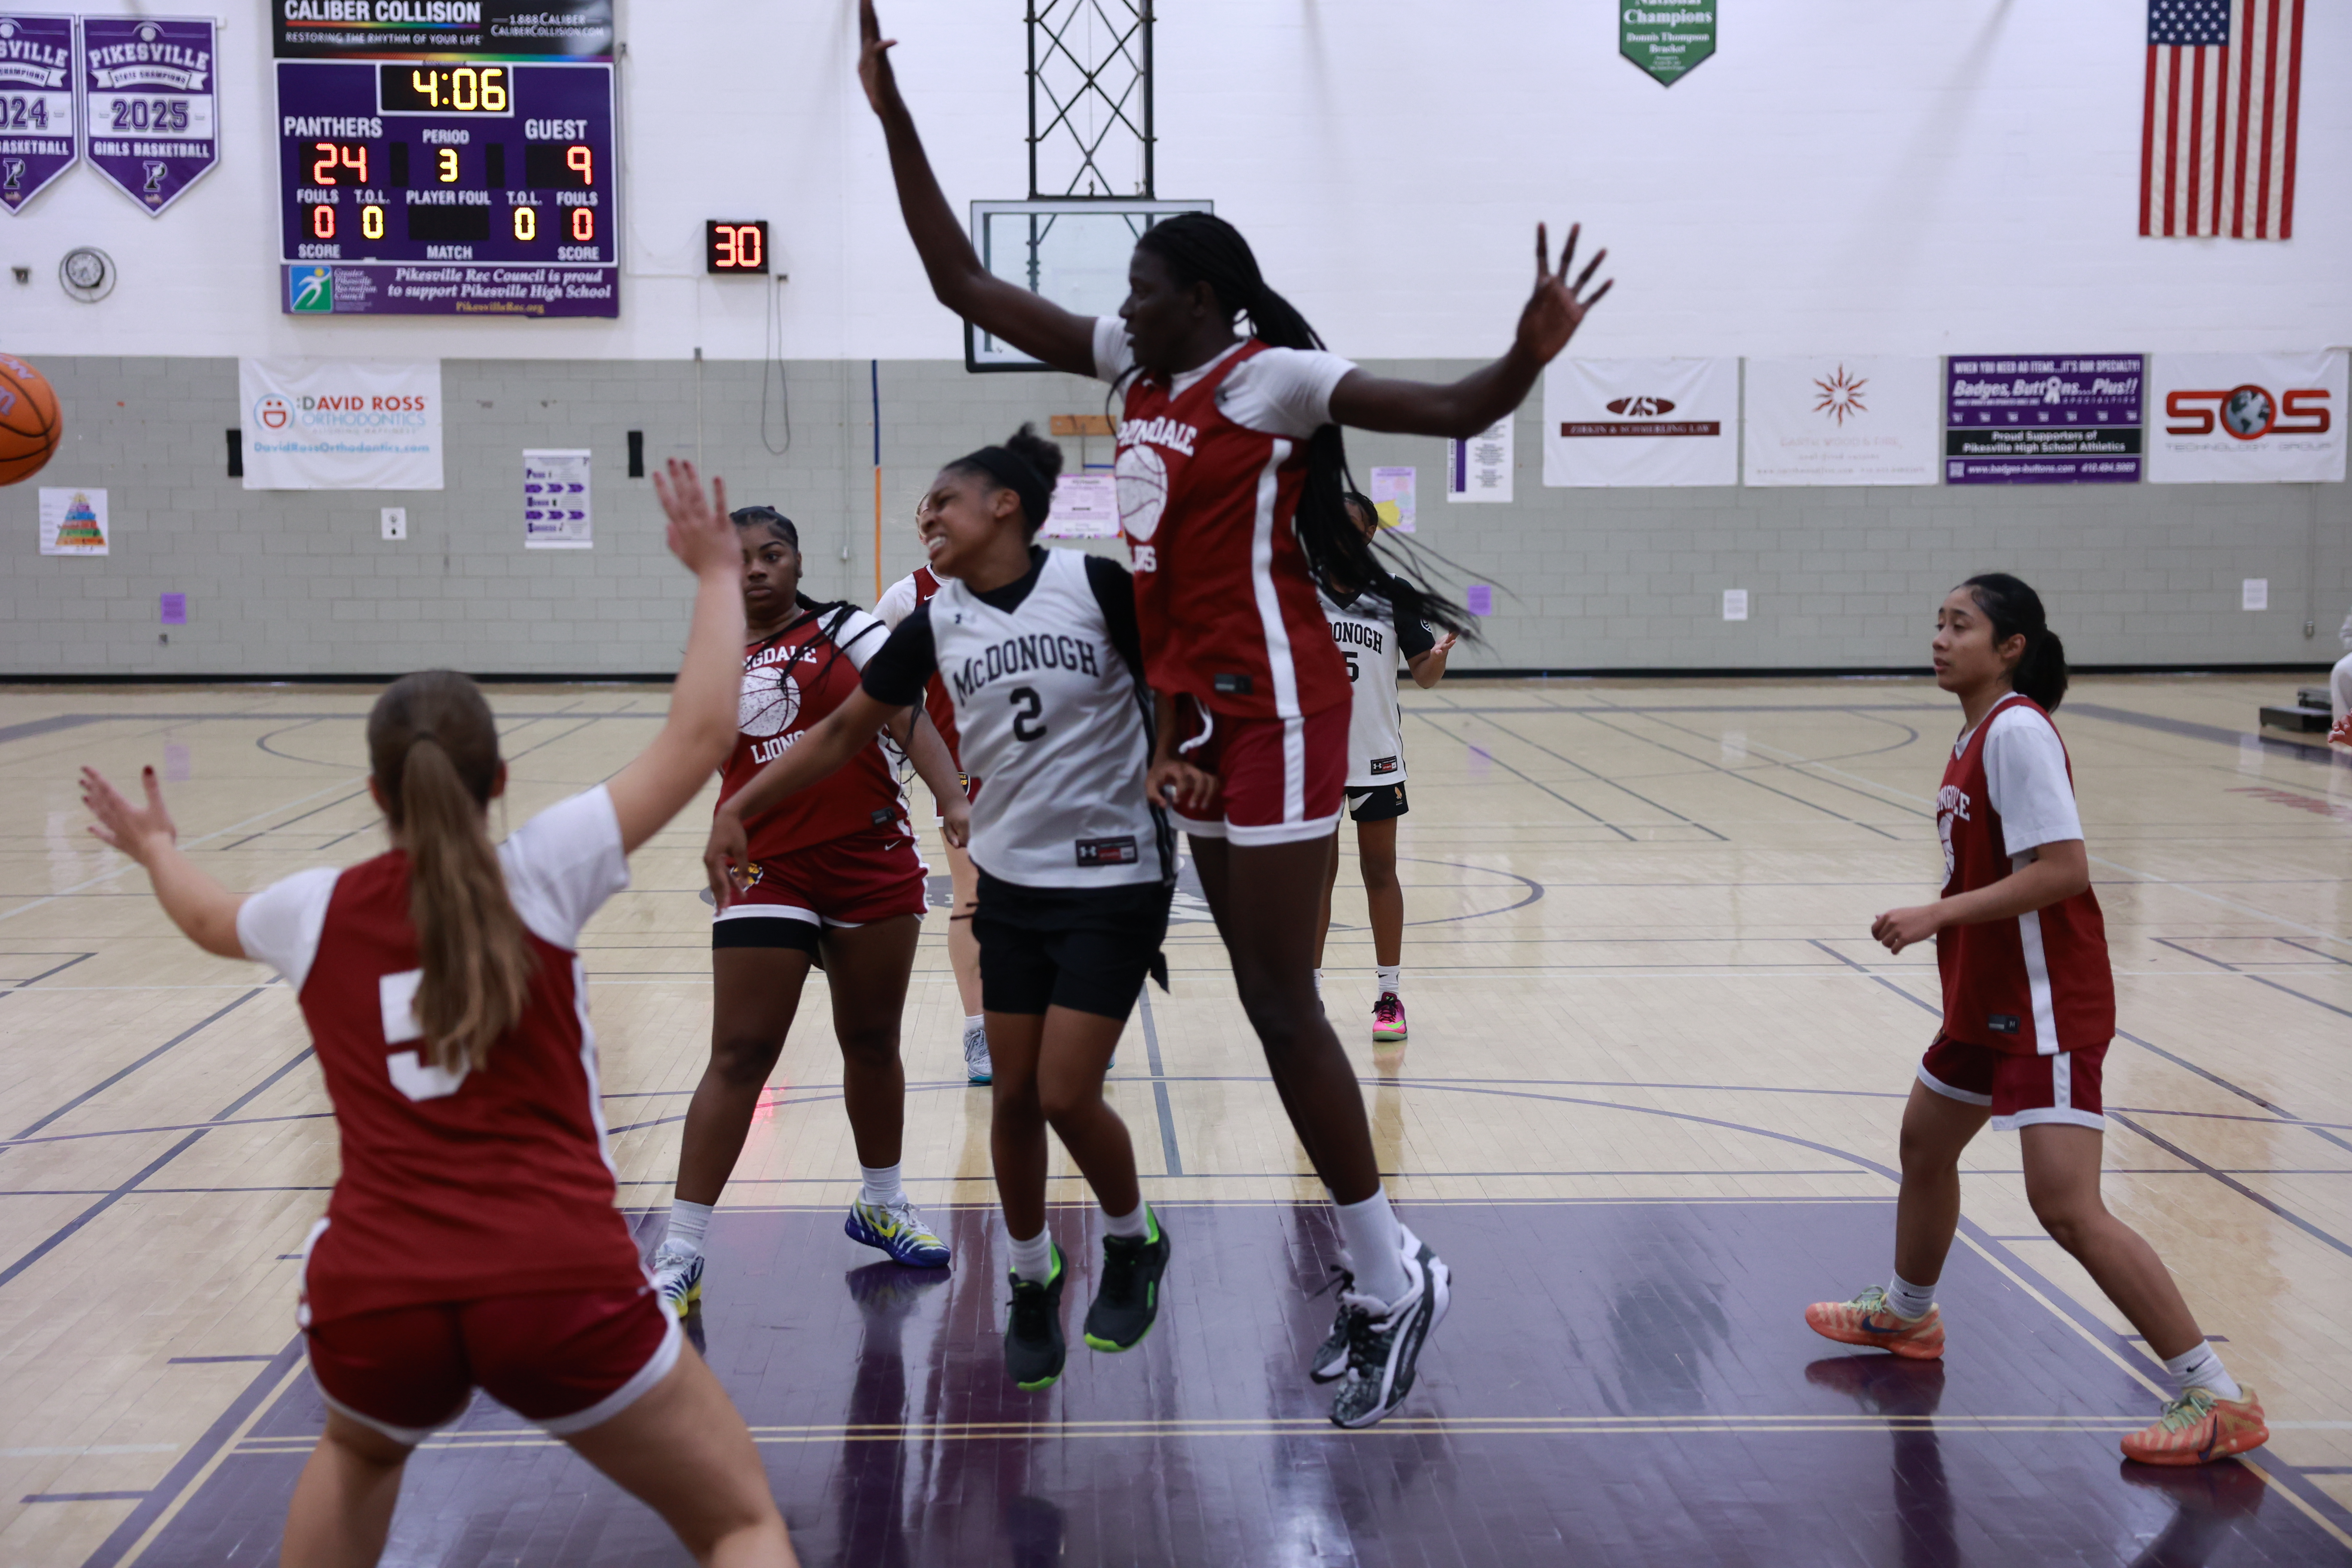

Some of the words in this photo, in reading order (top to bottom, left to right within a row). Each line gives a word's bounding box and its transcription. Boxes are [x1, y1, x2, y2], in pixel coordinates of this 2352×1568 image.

[284, 0, 371, 21] CALIBER
[375, 0, 481, 22] COLLISION
[1623, 8, 1712, 28] Champions
[285, 32, 343, 43] RESTORING
[344, 33, 366, 43] THE
[367, 33, 410, 44] RHYTHM
[413, 34, 427, 45] OF
[429, 34, 458, 45] YOUR
[460, 34, 482, 46] LIFE
[1661, 32, 1709, 44] Thompson
[1649, 43, 1686, 53] Bracket
[88, 43, 210, 71] PIKESVILLE
[413, 68, 506, 110] 4:06
[111, 97, 189, 132] 2025
[284, 116, 383, 138] PANTHERS
[524, 119, 588, 140] GUEST
[423, 129, 470, 145] PERIOD
[94, 141, 130, 156] GIRLS
[133, 141, 210, 158] BASKETBALL
[314, 143, 367, 185] 24
[439, 148, 458, 182] 3
[567, 146, 592, 185] 9
[297, 189, 340, 204] FOULS
[354, 189, 391, 204] T.O.L.
[406, 190, 456, 205] PLAYER
[459, 190, 492, 205] FOUL
[506, 191, 543, 206] T.O.L.
[556, 191, 598, 206] FOULS
[314, 205, 336, 239] 0
[362, 205, 383, 239] 0
[514, 207, 535, 240] 0
[573, 208, 593, 241] 0
[298, 244, 341, 259] SCORE
[426, 245, 473, 260] MATCH
[557, 246, 600, 261] SCORE
[715, 226, 761, 267] 30
[395, 267, 463, 282] Pikesville
[466, 268, 491, 283] Rec
[493, 268, 546, 283] Council
[548, 269, 560, 283] is
[562, 269, 603, 287] proud
[388, 283, 403, 297] to
[405, 284, 458, 301] support
[461, 283, 528, 298] Pikesville
[529, 284, 563, 302] High
[565, 284, 611, 299] School
[456, 301, 545, 315] PikesvilleRec.org
[1953, 361, 1978, 374] WHEN
[1979, 361, 1995, 374] YOU
[1953, 379, 2011, 399] Badges,
[372, 396, 425, 411] ROSS
[302, 411, 426, 427] ORTHODONTICS
[1991, 431, 2024, 442] Proud
[2024, 430, 2084, 442] Supporters
[2084, 430, 2098, 441] of
[254, 442, 429, 453] DavidRossOrthodontics.com
[1962, 442, 2013, 453] Pikesville
[2013, 441, 2040, 454] High
[2040, 441, 2077, 453] School
[2078, 441, 2125, 452] Athletics
[2165, 442, 2270, 452] TECHNOLOGY
[2279, 441, 2331, 451] GROUP
[1341, 651, 1359, 683] 5
[1010, 686, 1047, 742] 2
